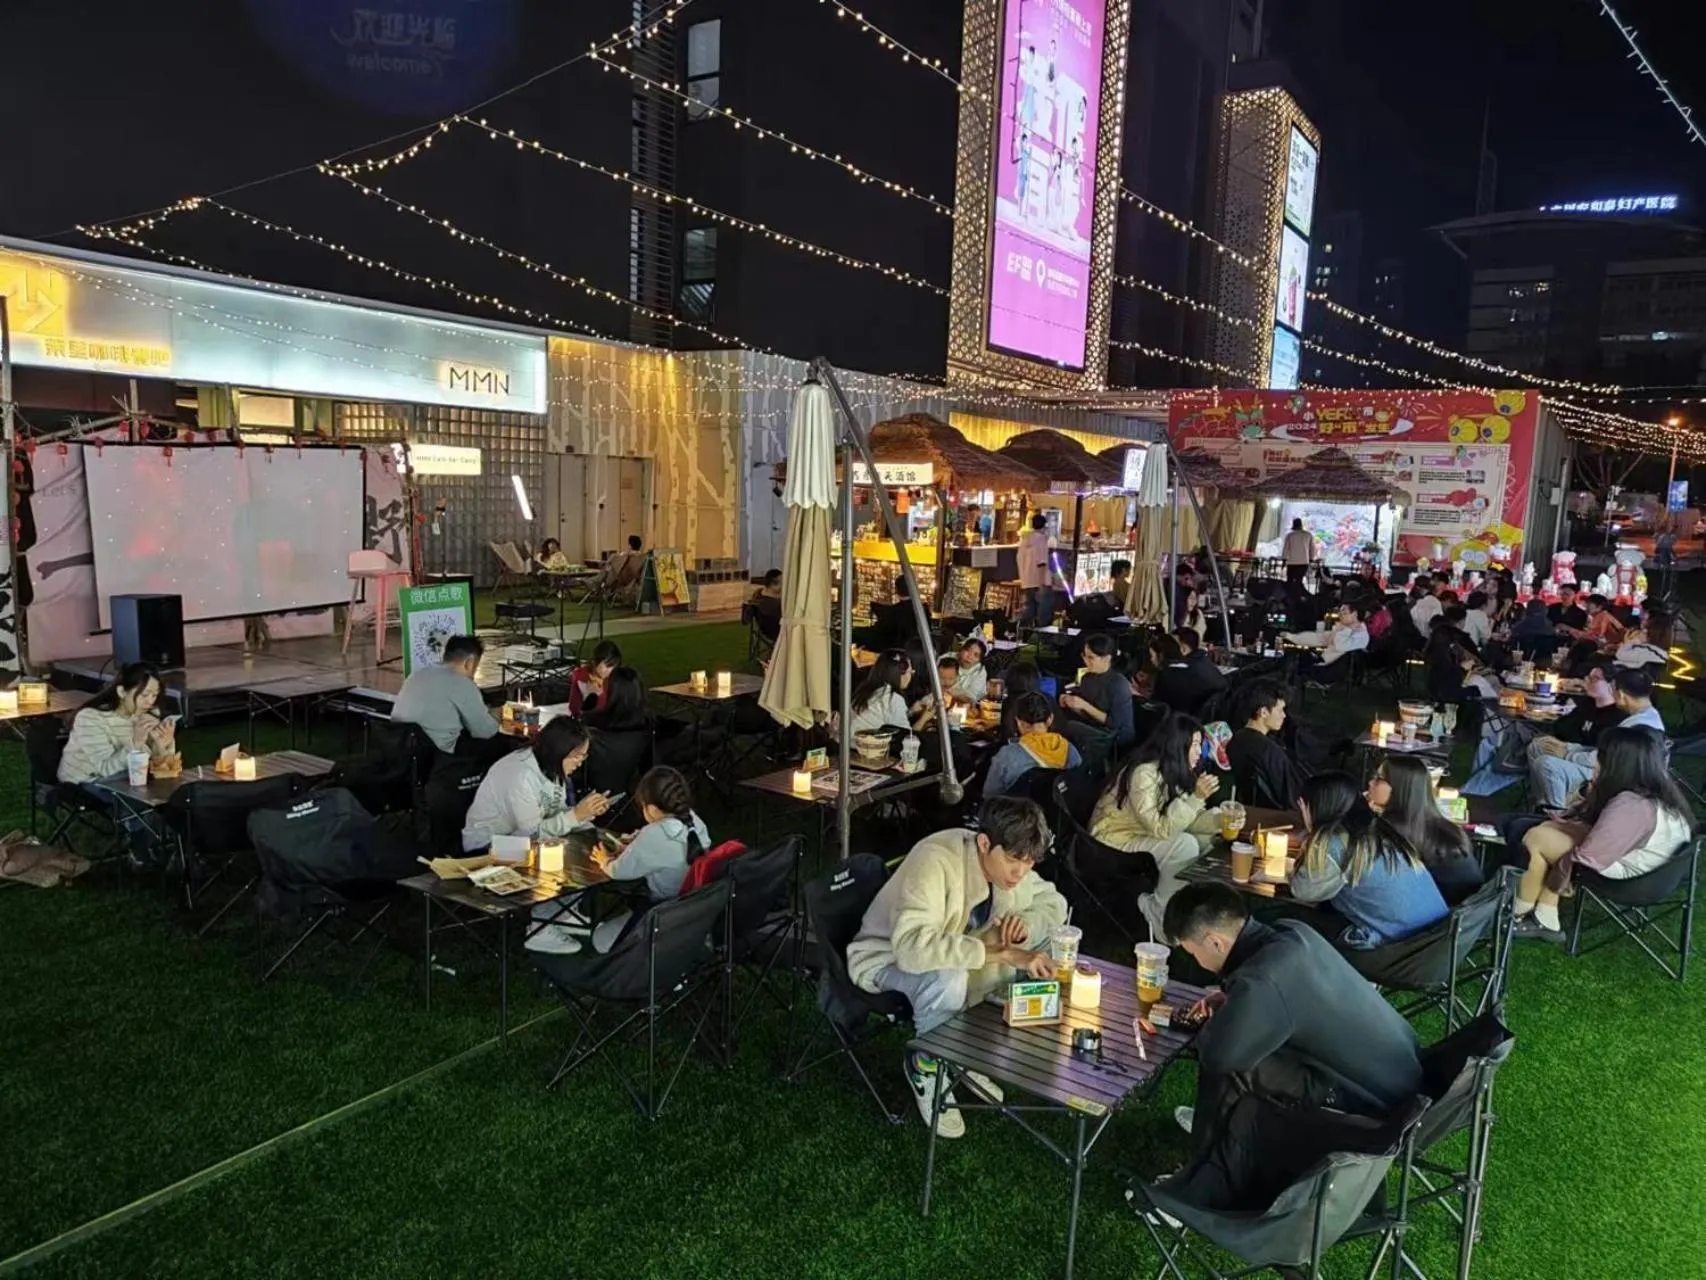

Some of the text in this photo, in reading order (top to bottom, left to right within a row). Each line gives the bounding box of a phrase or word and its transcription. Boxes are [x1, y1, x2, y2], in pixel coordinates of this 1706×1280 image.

[449, 367, 509, 395] MMN
[1287, 423, 1317, 431] 2024
[410, 587, 464, 604] 微信点歌
